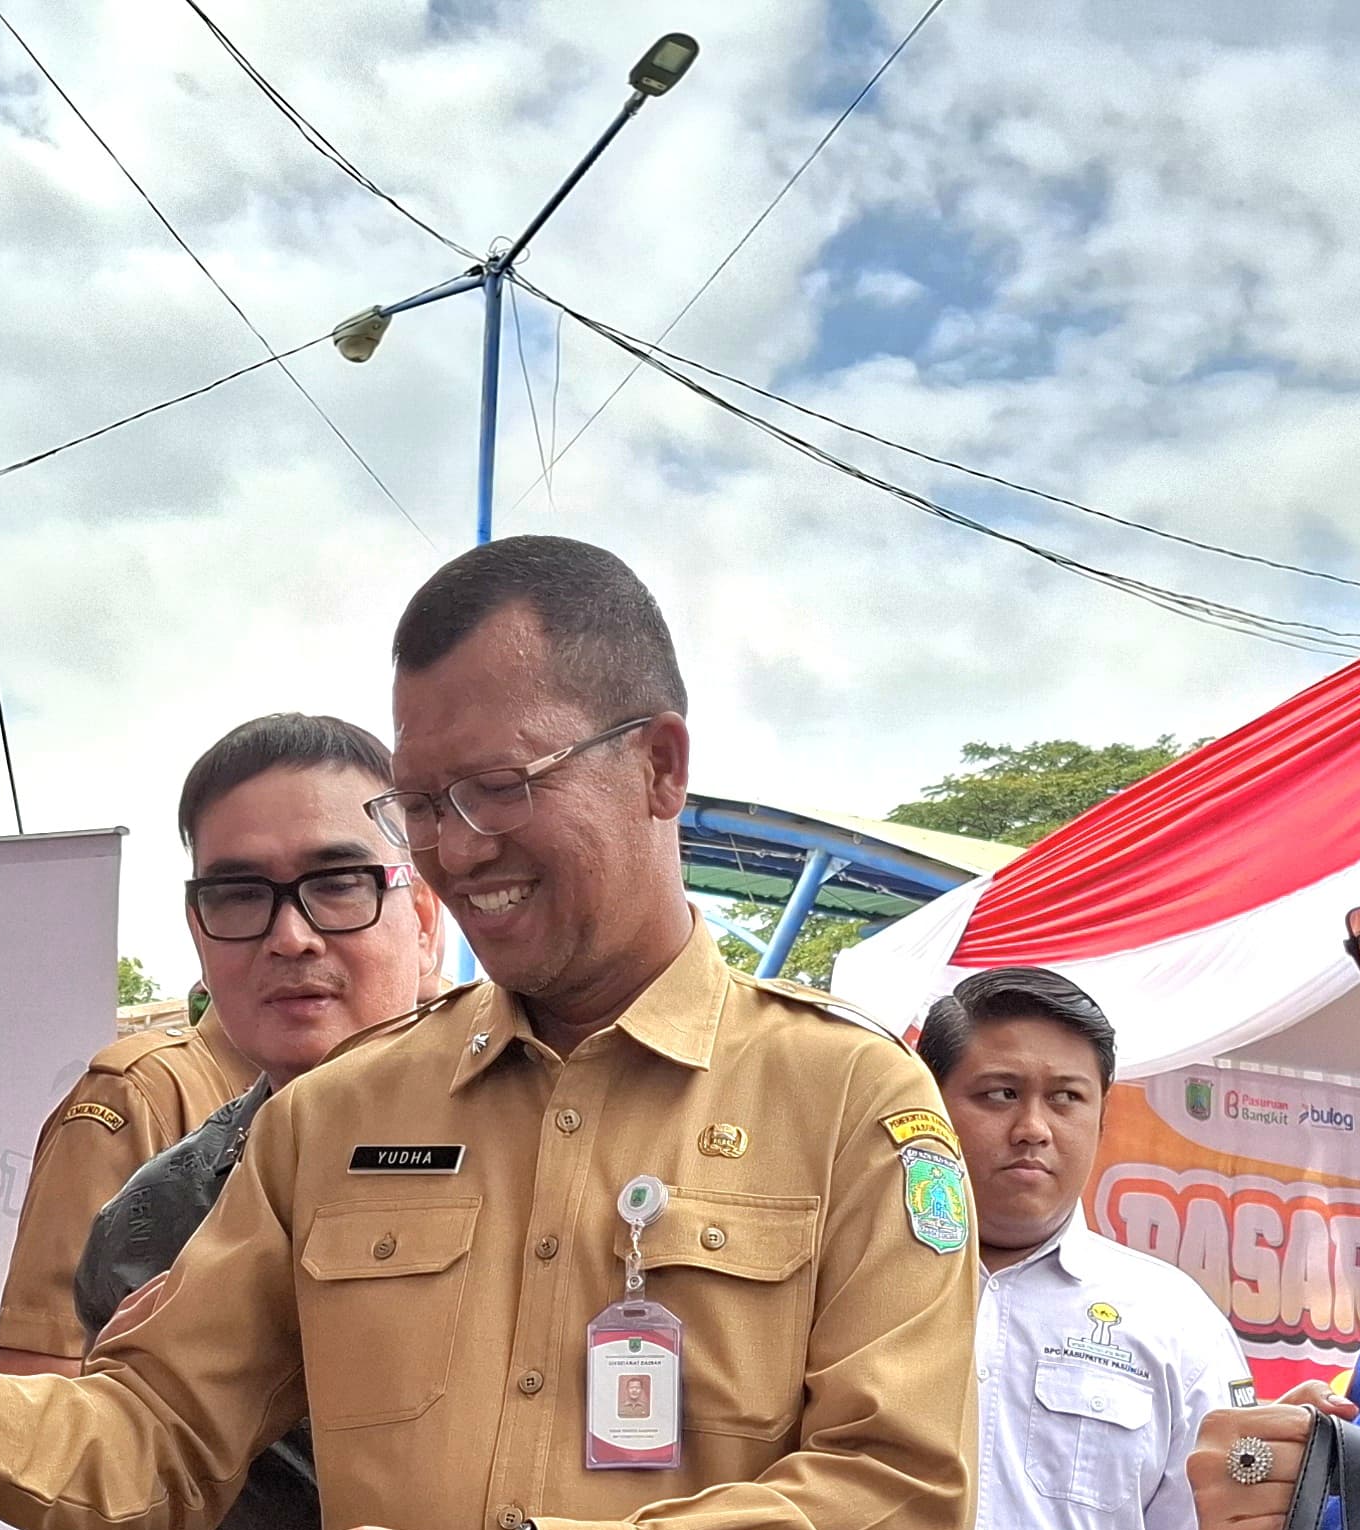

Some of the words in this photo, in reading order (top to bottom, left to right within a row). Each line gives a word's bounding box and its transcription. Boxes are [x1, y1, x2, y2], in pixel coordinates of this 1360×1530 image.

[1242, 1095, 1289, 1110] Pasuruan
[1242, 1108, 1289, 1126] Bangkit
[1311, 1105, 1354, 1131] bulog
[377, 1150, 433, 1166] YUDHA
[1062, 1348, 1109, 1367] KABUPATEN
